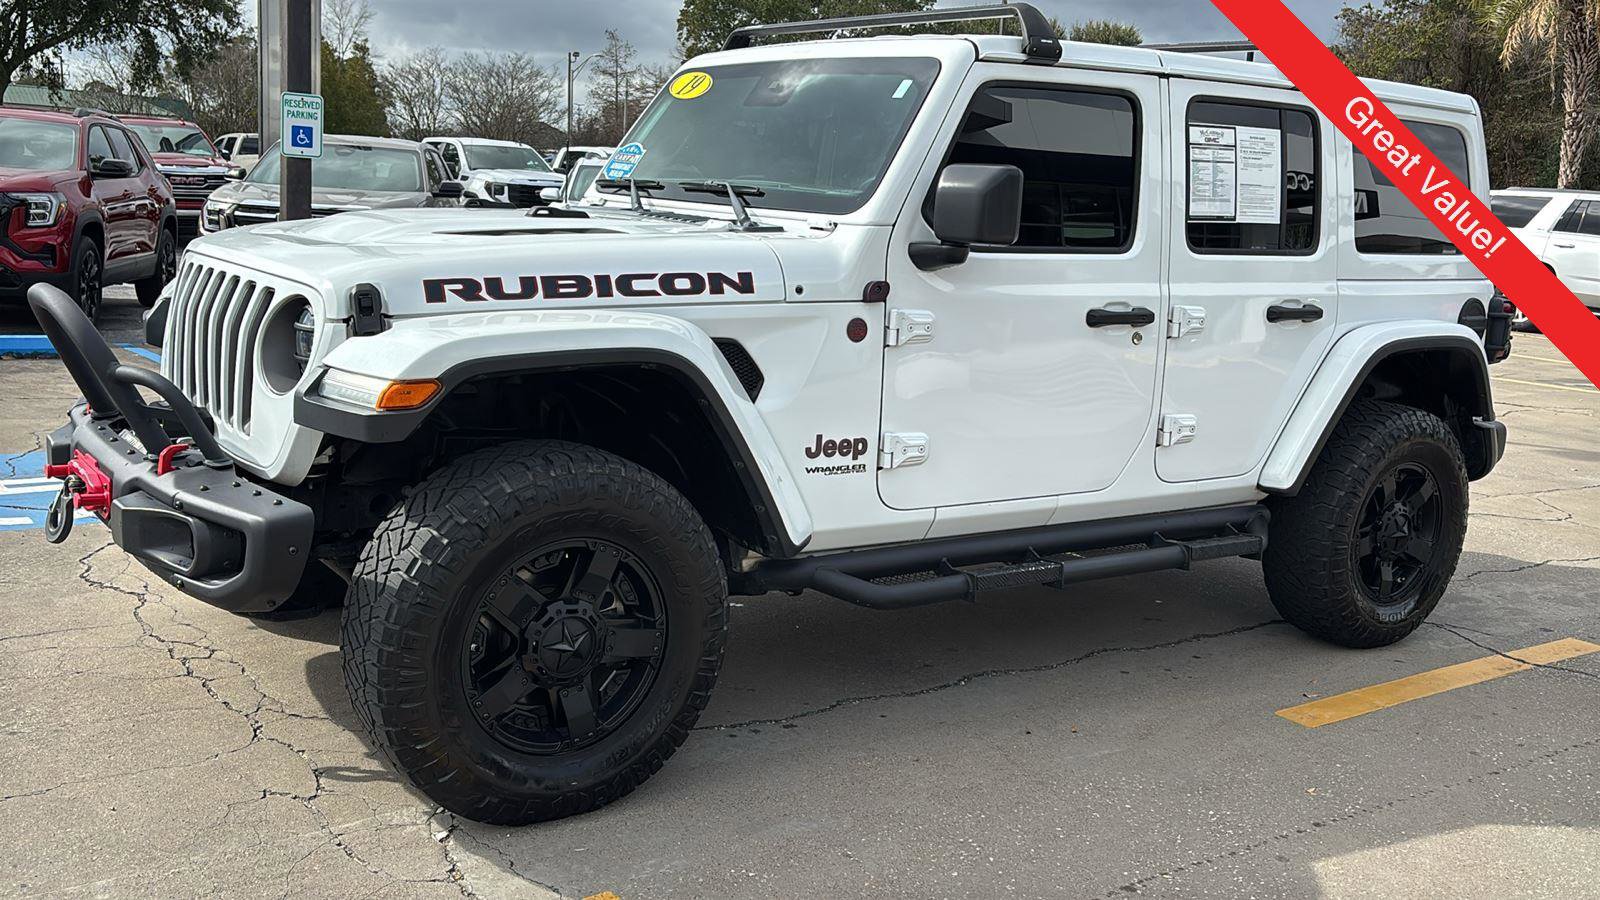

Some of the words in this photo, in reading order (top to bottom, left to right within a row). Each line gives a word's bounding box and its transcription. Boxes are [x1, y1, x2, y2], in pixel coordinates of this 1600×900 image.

[675, 75, 707, 94] 19
[284, 99, 321, 109] RESERVED
[287, 110, 318, 120] PARKING
[169, 176, 205, 184] GMC
[422, 271, 755, 303] RUBICON
[805, 434, 868, 460] Jeep
[805, 464, 866, 474] WRANGLER
